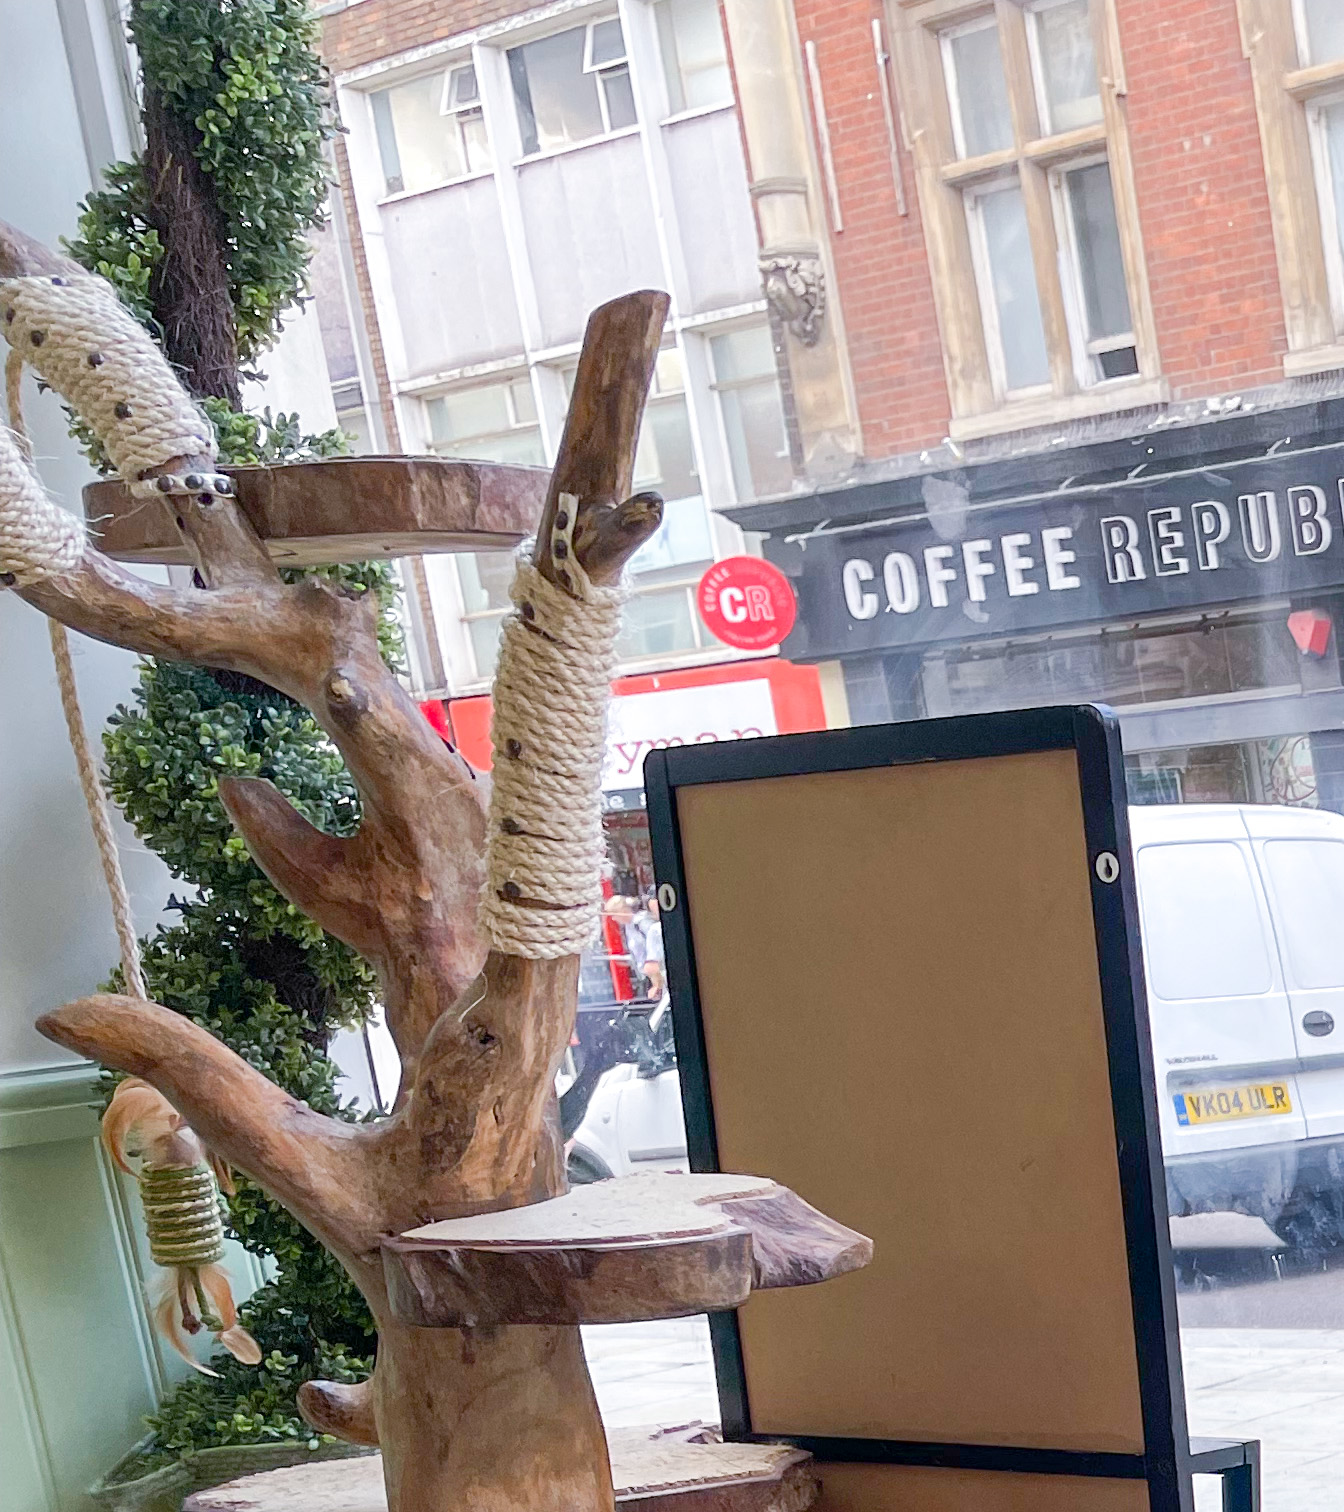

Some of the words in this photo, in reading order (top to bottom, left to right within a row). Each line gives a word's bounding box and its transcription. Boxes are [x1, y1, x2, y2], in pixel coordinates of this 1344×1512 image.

[842, 526, 1081, 622] COFFEE
[719, 585, 776, 623] CR
[1189, 1092, 1243, 1118] VK04
[1250, 1086, 1286, 1109] ULR
